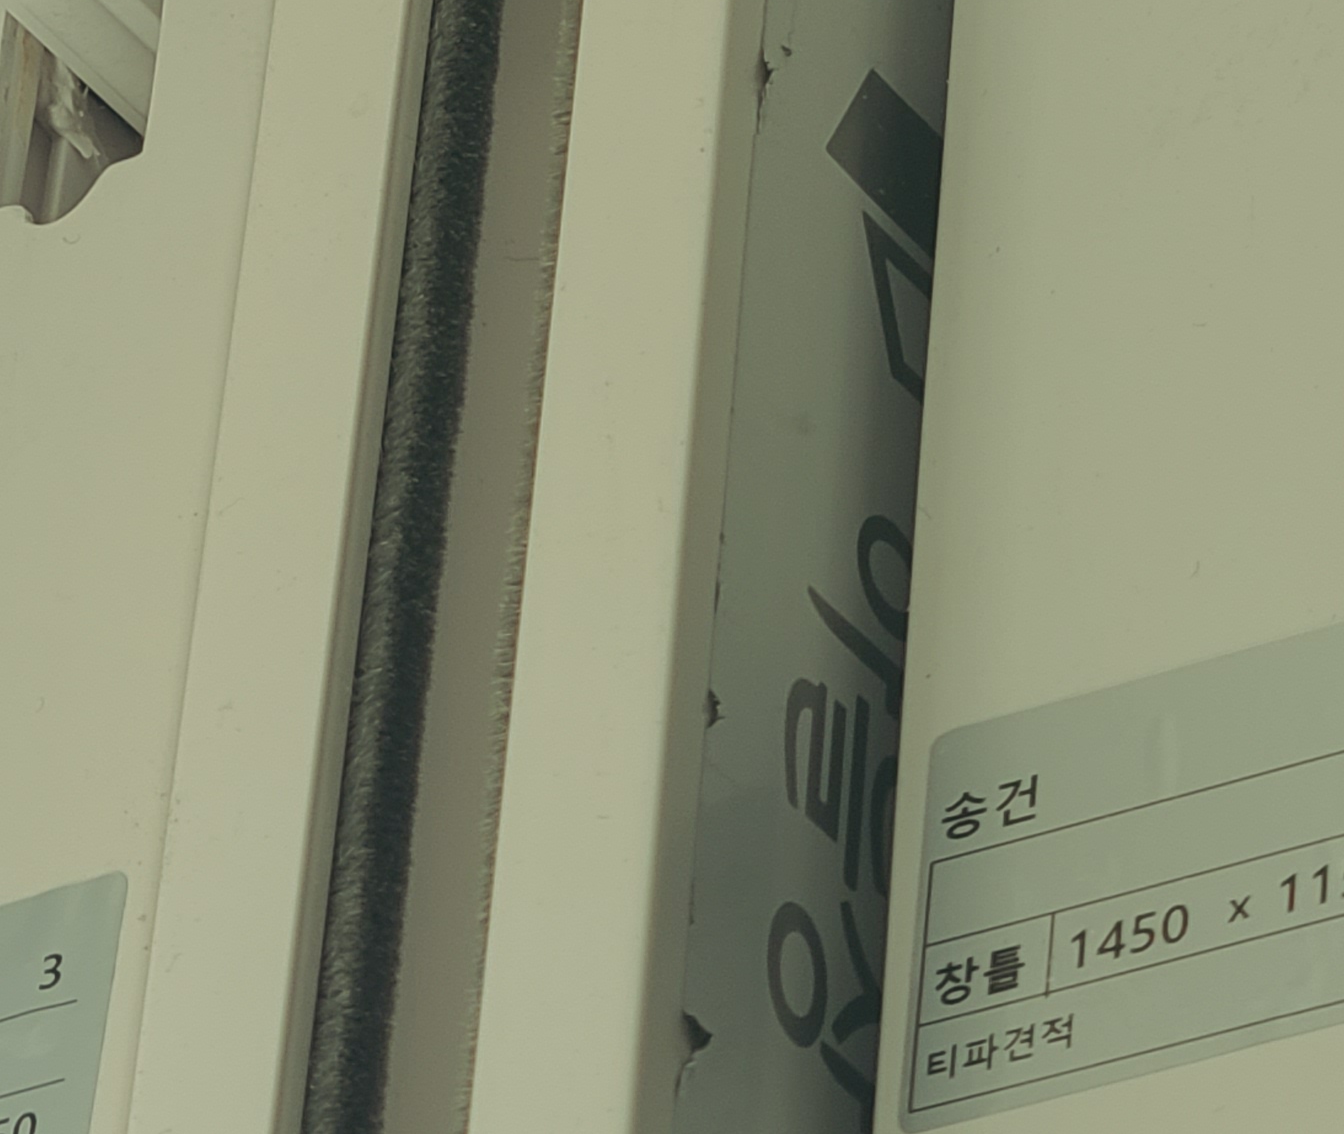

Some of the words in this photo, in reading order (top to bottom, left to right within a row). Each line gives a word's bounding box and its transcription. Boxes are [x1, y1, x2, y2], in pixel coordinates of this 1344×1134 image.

[941, 774, 1039, 841] 송건
[38, 953, 63, 991] 3
[935, 944, 1026, 1006] 창틀
[1069, 904, 1190, 969] 1450
[926, 1013, 1076, 1080] 티파견적
